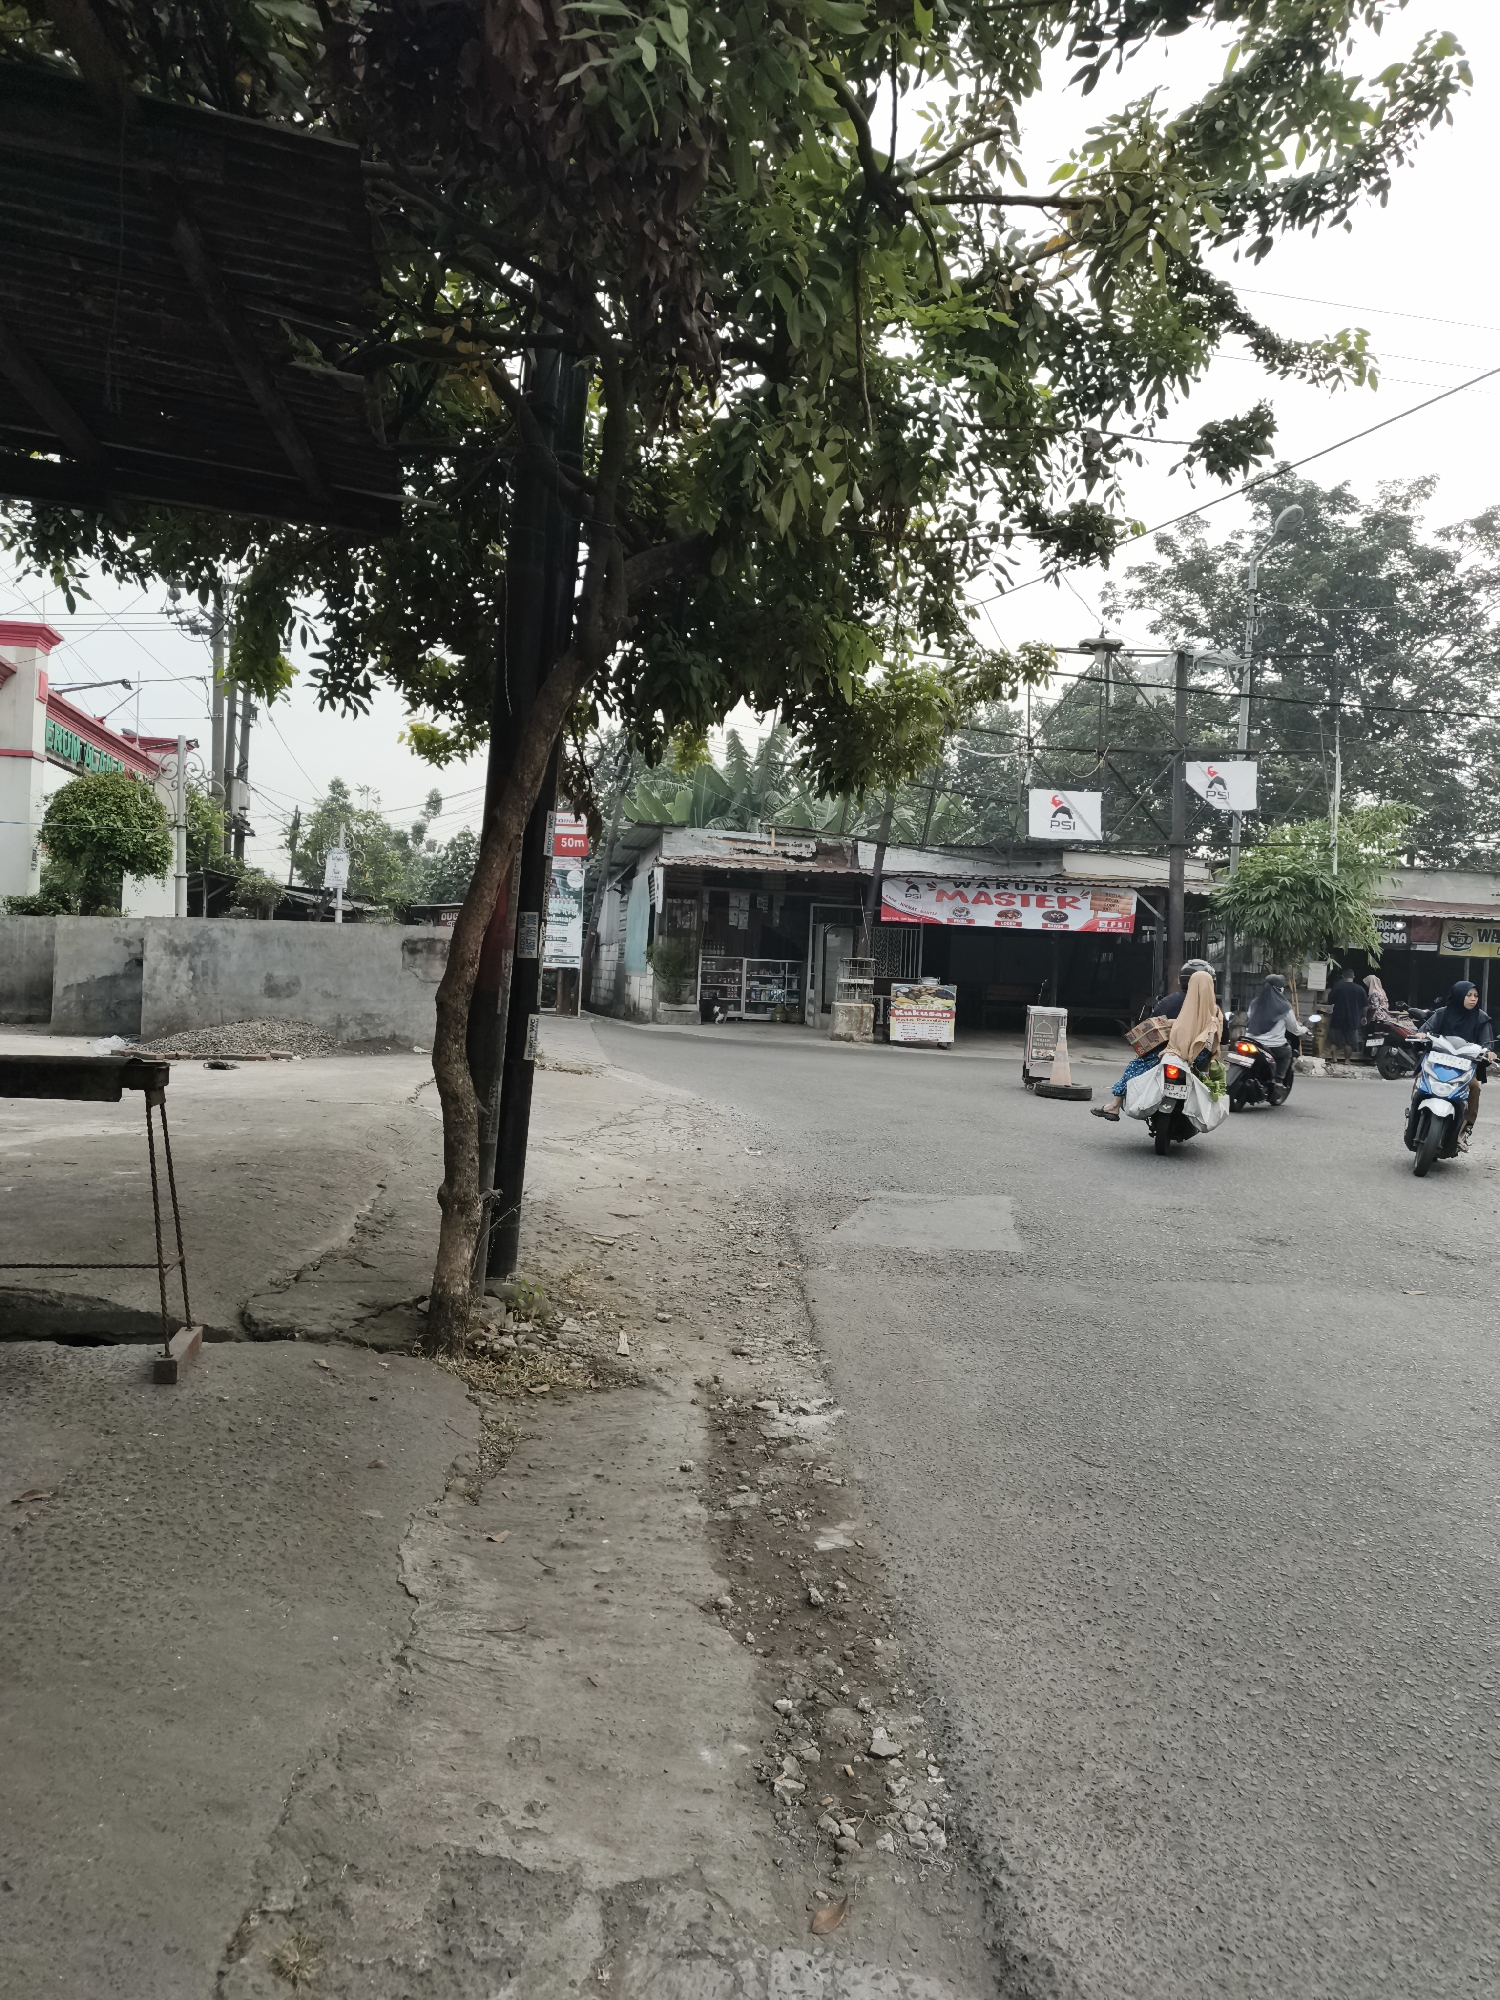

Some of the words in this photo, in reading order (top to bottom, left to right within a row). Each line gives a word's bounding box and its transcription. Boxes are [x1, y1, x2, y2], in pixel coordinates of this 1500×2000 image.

[1205, 791, 1230, 800] PSI
[1050, 820, 1076, 831] PSI
[561, 837, 585, 848] 50m
[952, 880, 1068, 894] WARUNG
[935, 889, 1082, 911] MASTER
[519, 914, 526, 929] WC
[894, 1009, 951, 1018] Kukusan
[529, 1018, 536, 1033] WC
